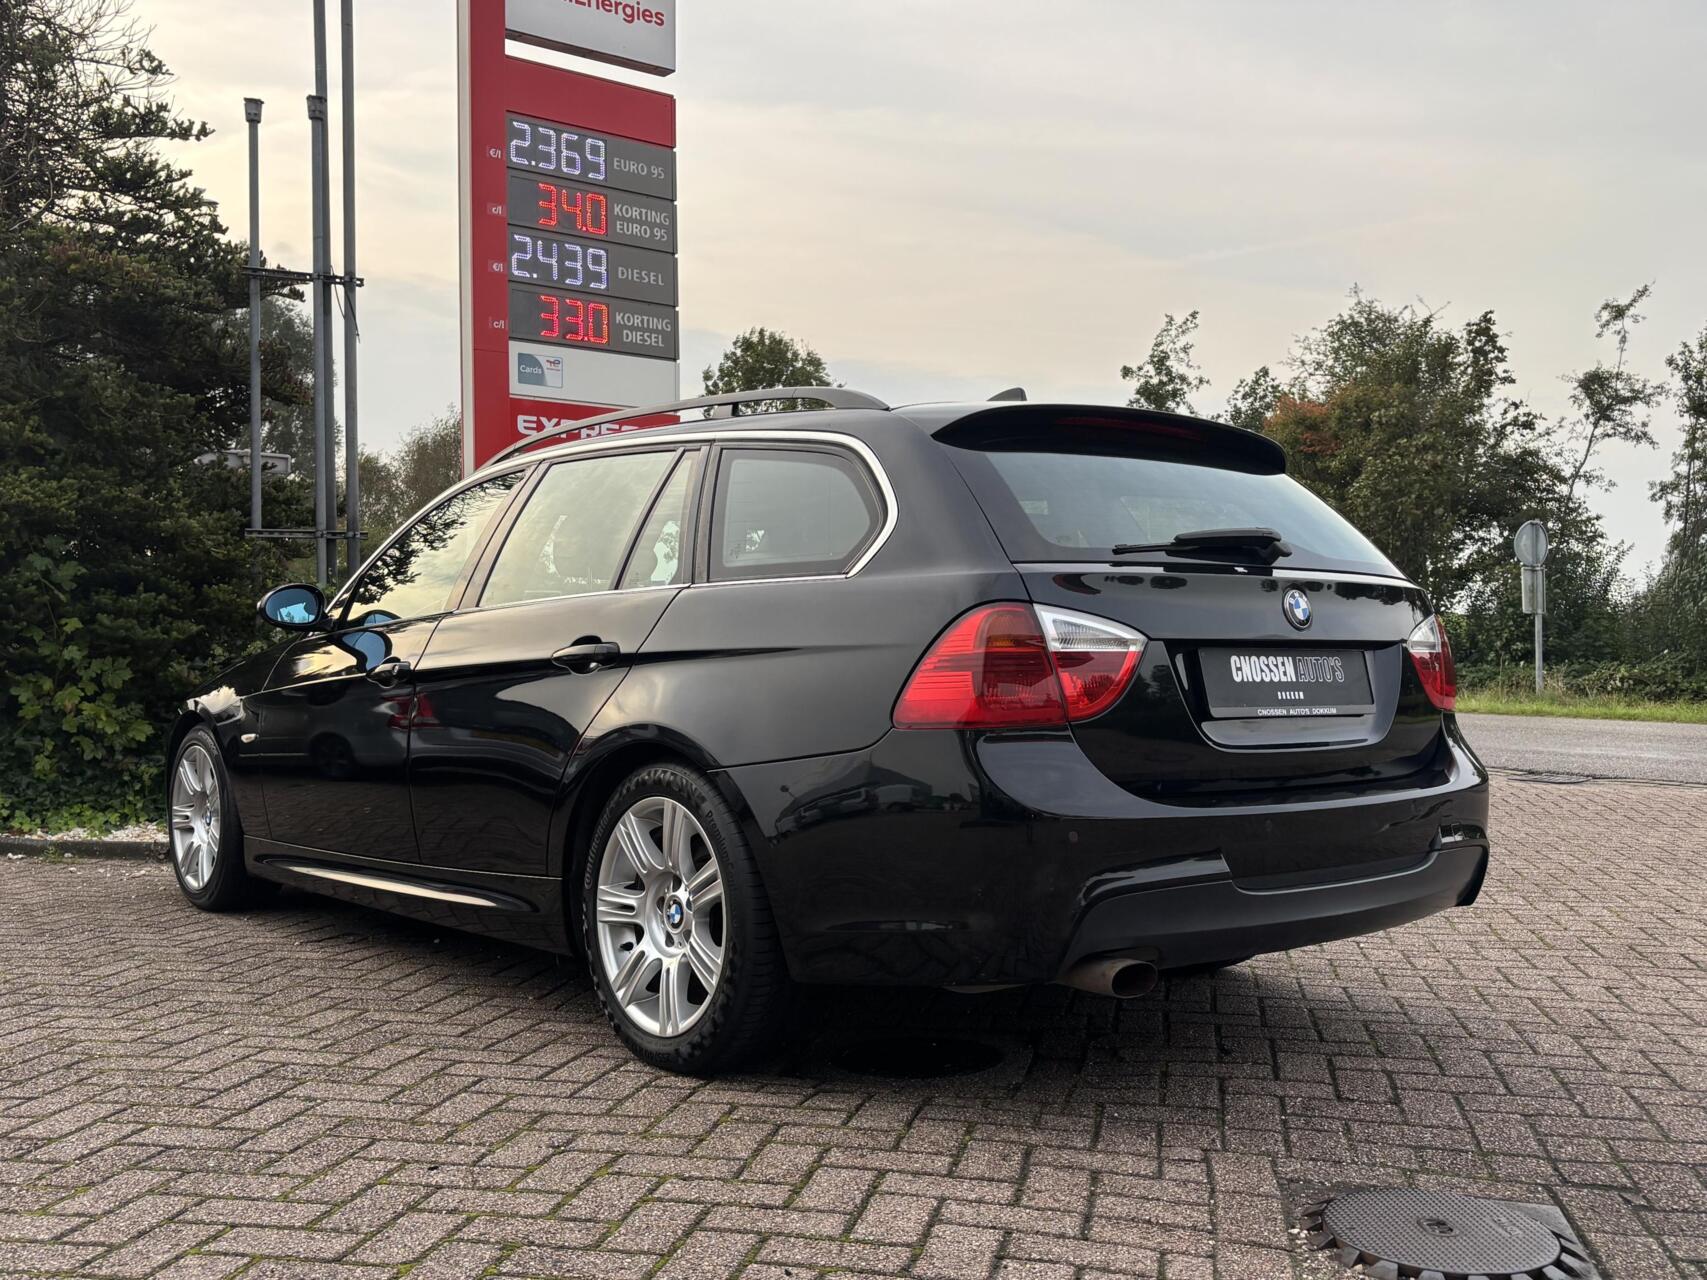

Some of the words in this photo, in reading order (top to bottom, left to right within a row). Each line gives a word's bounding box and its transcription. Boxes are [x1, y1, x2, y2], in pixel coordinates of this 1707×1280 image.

[510, 121, 606, 181] 2.369
[613, 157, 647, 175] EURO
[651, 165, 665, 179] 95
[614, 203, 670, 226] KORTING
[616, 221, 650, 239] EURO
[654, 227, 668, 241] 95
[511, 234, 608, 290] 2.439
[618, 266, 665, 286] DIESEL
[616, 311, 672, 332] KORTING
[623, 329, 665, 347] DIESEL
[519, 364, 542, 374] Cards
[517, 414, 640, 440] EXPRE
[1230, 655, 1296, 682] CNOSSEN
[1296, 656, 1345, 683] AUTO'S
[1257, 708, 1287, 716] CNOSSEN
[1312, 707, 1337, 715] DOKKUM
